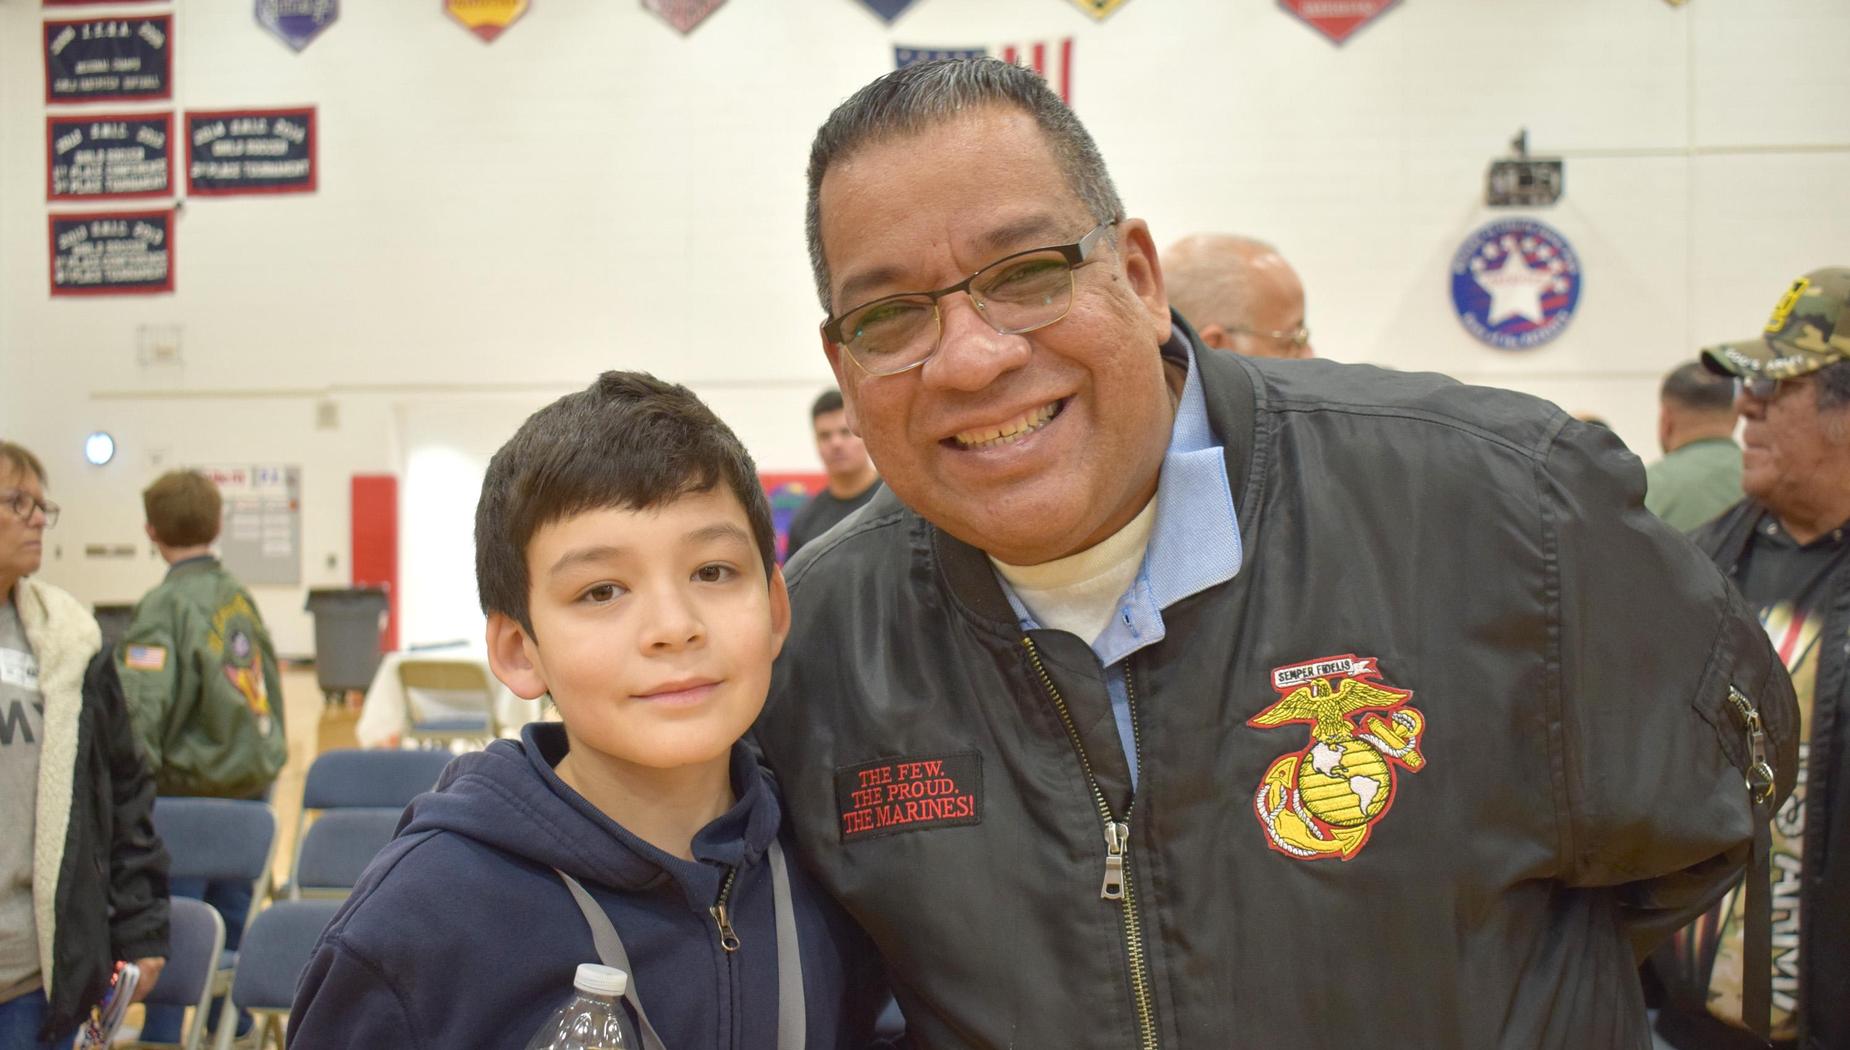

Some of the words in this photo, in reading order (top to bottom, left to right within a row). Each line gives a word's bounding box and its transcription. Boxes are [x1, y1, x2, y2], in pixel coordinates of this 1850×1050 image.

[1278, 666, 1314, 682] SEMPER
[1316, 660, 1351, 674] FIDELIS
[859, 766, 892, 788] THE
[897, 760, 945, 781] FEW.
[851, 787, 883, 808] THE
[887, 778, 960, 802] PROUD.
[843, 808, 874, 833] THE
[875, 794, 975, 827] MARINES!
